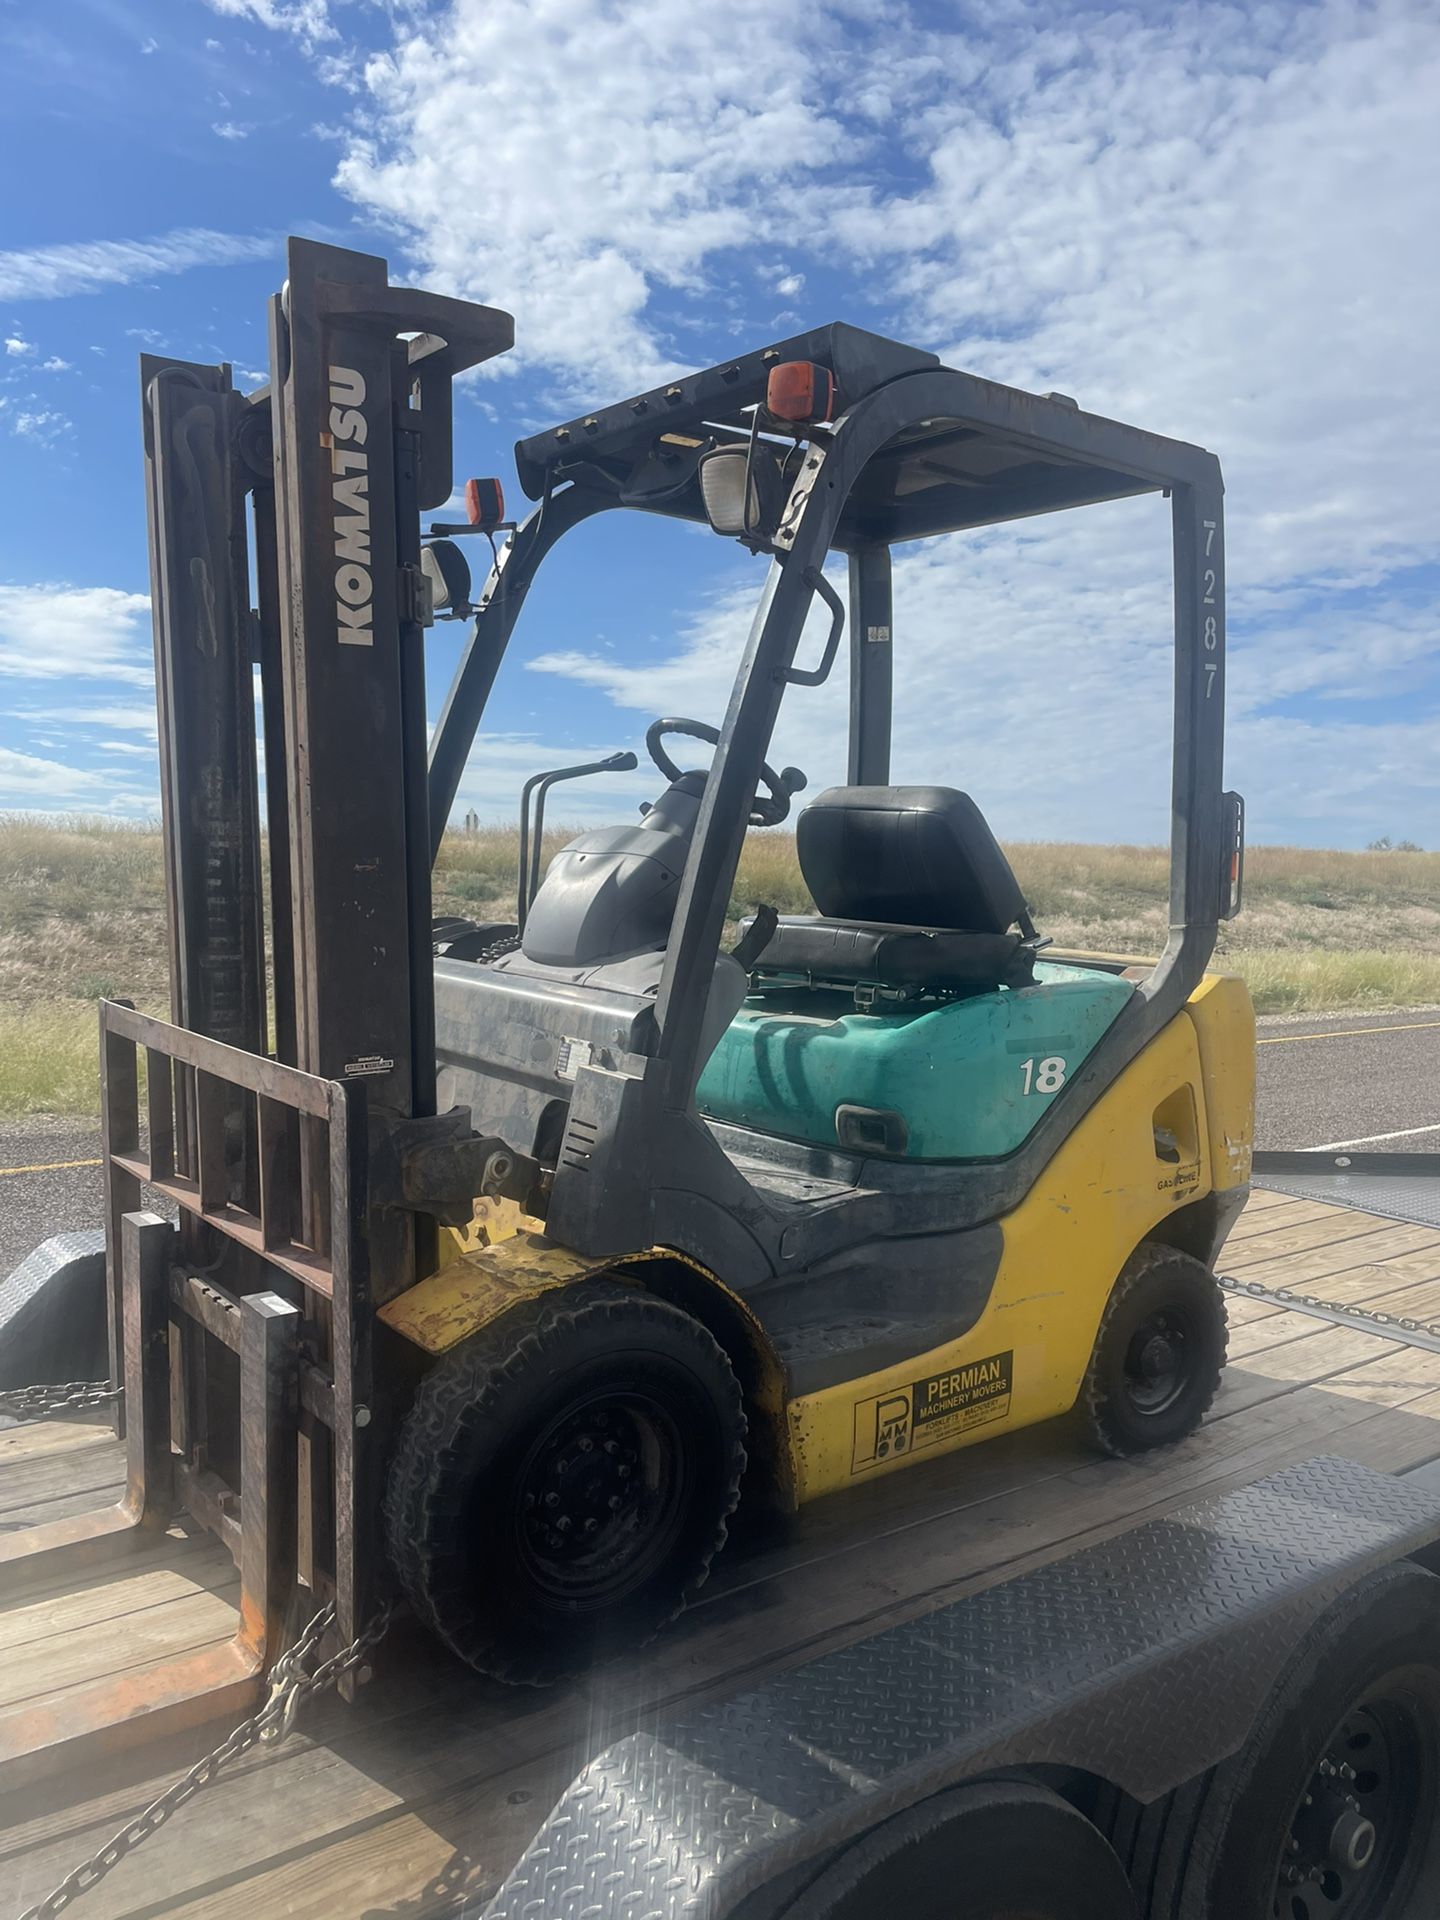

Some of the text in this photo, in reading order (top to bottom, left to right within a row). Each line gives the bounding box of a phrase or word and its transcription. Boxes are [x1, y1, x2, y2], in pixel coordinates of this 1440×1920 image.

[321, 365, 374, 646] KOMATSU
[1020, 1056, 1067, 1096] 18
[919, 1379, 1007, 1419] MACHINERY MOVERS
[928, 1360, 1000, 1402] PERMIAN
